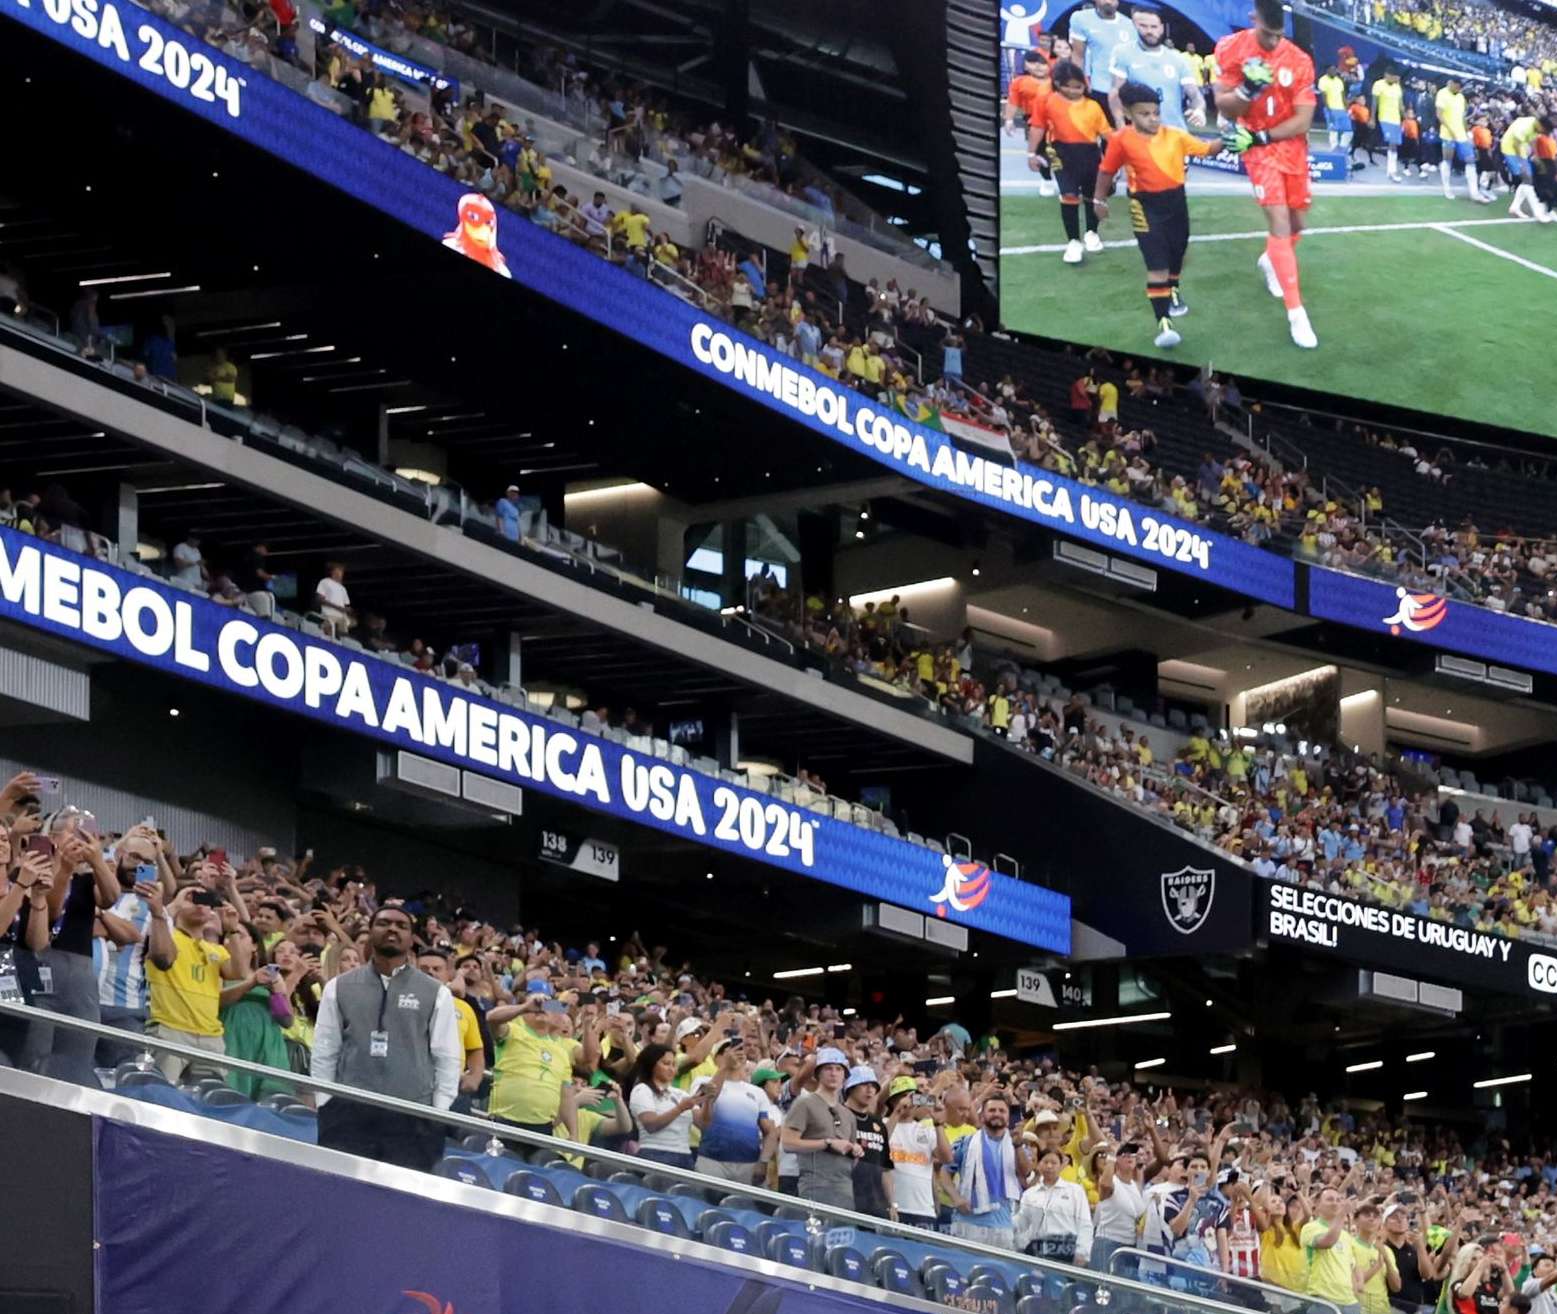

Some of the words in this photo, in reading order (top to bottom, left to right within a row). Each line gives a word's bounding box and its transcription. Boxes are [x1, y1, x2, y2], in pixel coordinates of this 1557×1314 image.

[138, 24, 240, 117] 2024
[691, 322, 854, 436] CONMEBOL
[856, 408, 930, 473] COPA
[930, 445, 1074, 524] AMERICA
[1081, 495, 1137, 546] USA
[1142, 516, 1209, 569] 2024
[217, 620, 378, 727] COPA
[382, 677, 610, 804] AMERICA
[621, 754, 706, 835] USA
[714, 787, 814, 867] 2024
[542, 831, 567, 852] 138
[592, 846, 615, 865] 139
[1270, 915, 1338, 947] BRASIL!
[1271, 884, 1390, 934] SELECCIONES
[1392, 914, 1416, 938] DE
[1418, 923, 1498, 959] URUGUAY
[1499, 938, 1512, 961] Y
[1533, 961, 1557, 987] CC
